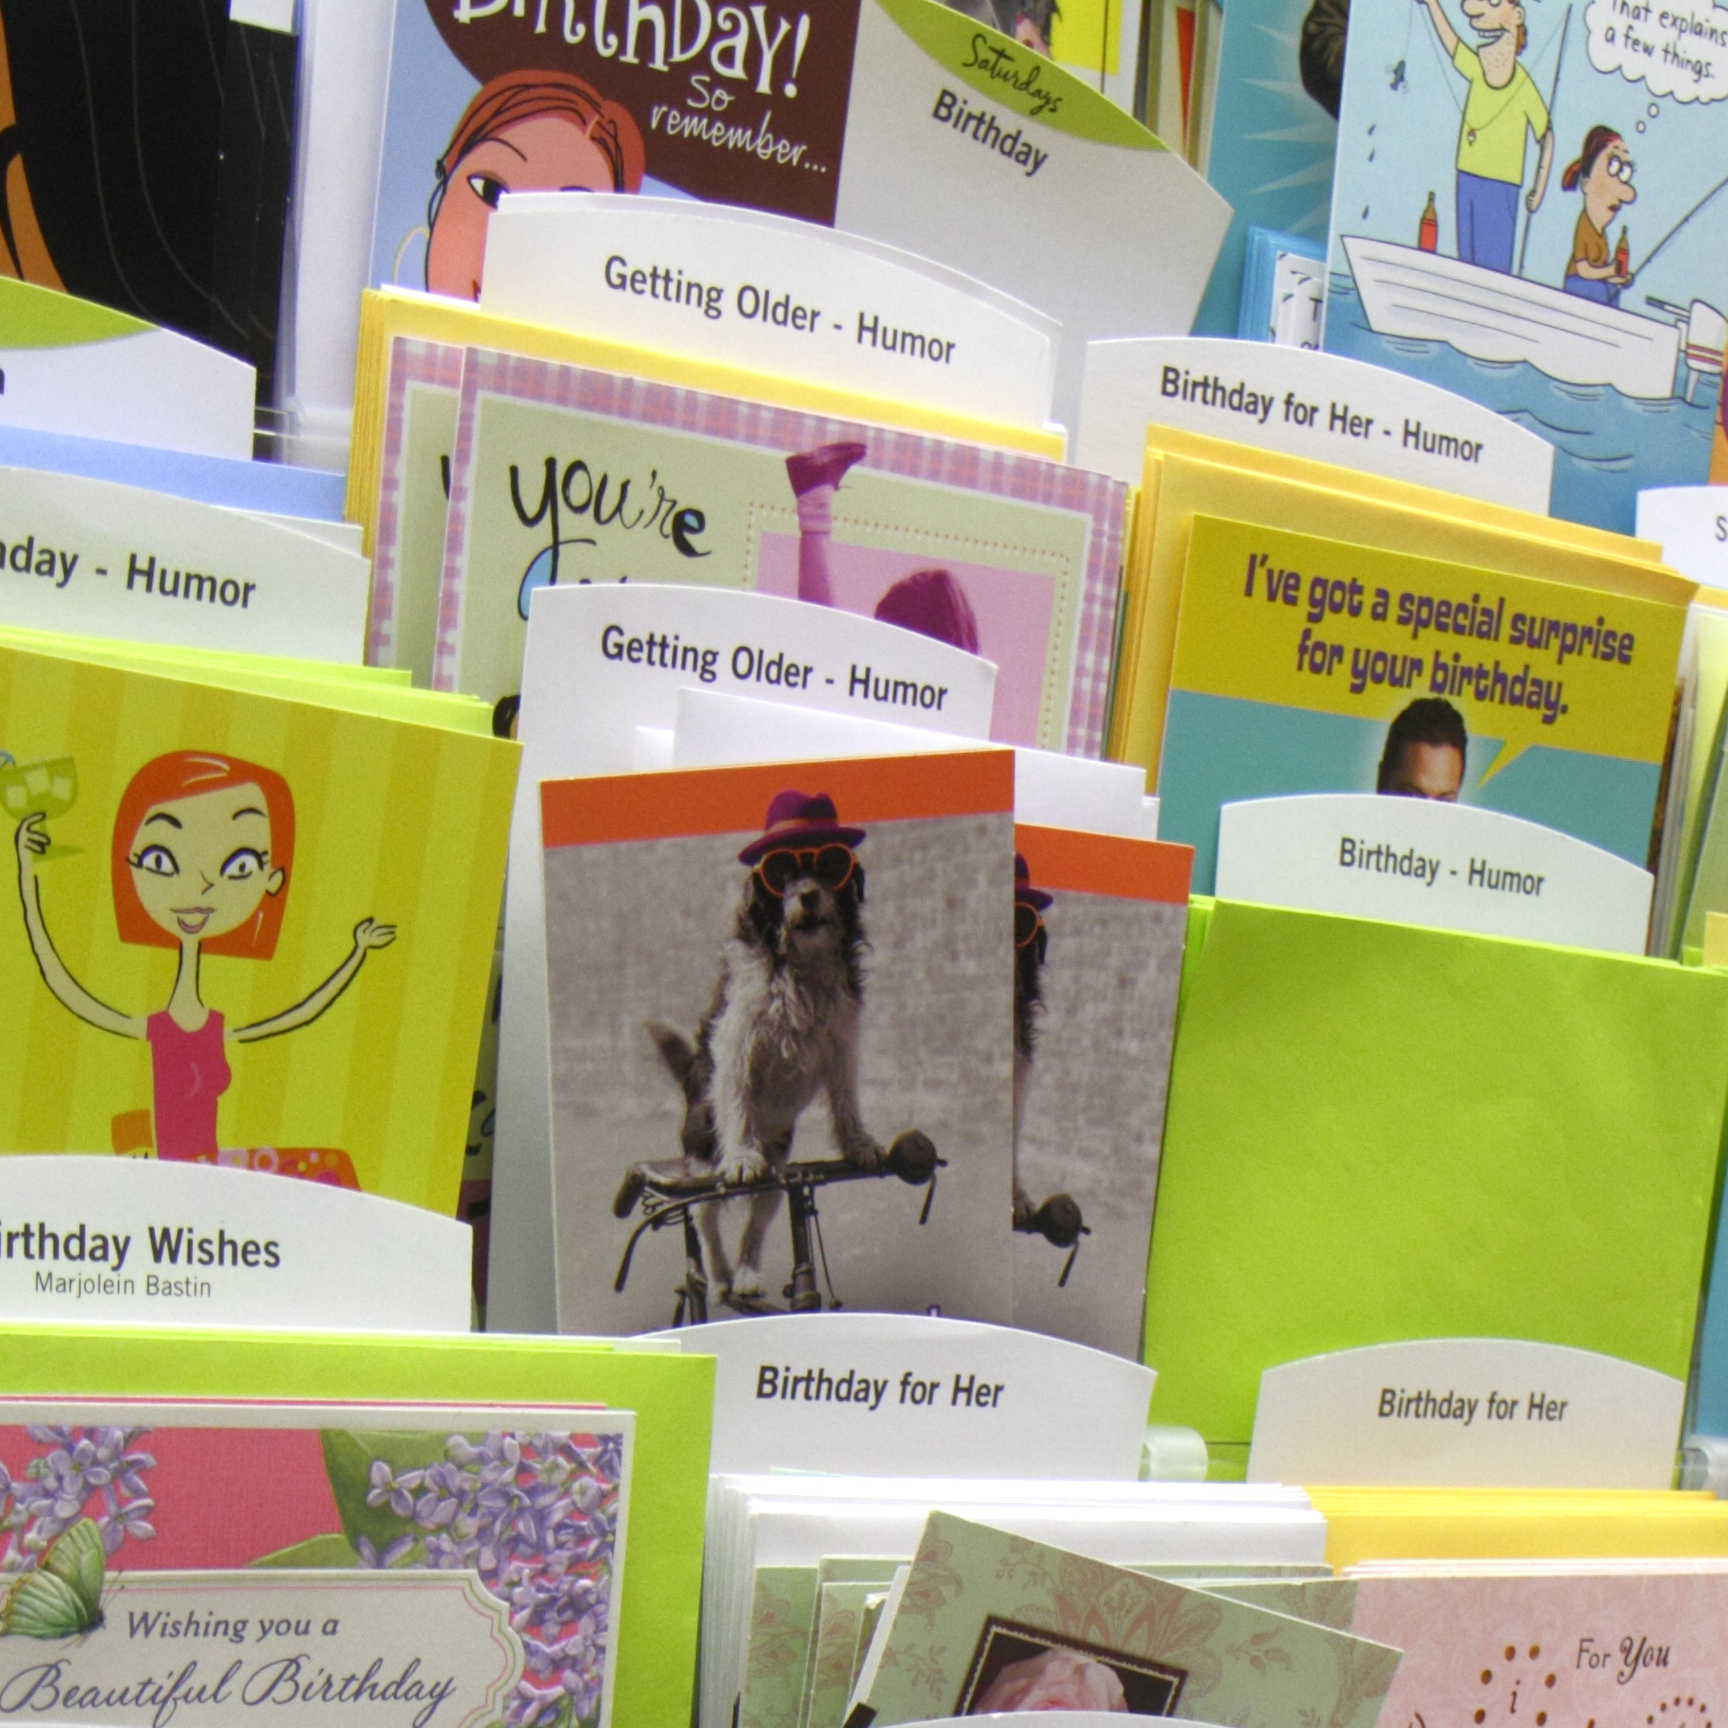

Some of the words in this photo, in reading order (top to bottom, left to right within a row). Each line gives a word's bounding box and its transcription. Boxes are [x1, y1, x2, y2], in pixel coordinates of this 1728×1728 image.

[1605, 26, 1615, 43] a
[1624, 24, 1654, 57] few
[1659, 11, 1728, 47] explains
[931, 89, 1050, 178] Birthday
[604, 254, 724, 319] Getting
[736, 285, 821, 333] Older
[857, 314, 956, 365] Humor
[1161, 365, 1274, 424] Birthday
[1284, 392, 1320, 426] for
[1328, 402, 1374, 440] Her
[1402, 419, 1483, 463] Humor
[126, 554, 256, 601] Humor
[1244, 553, 1299, 606] I've
[1307, 576, 1363, 621] got
[1371, 589, 1388, 621] a
[1397, 591, 1502, 642] special
[1509, 617, 1635, 664] surprise
[601, 625, 719, 682] Getting
[731, 645, 813, 688] Older
[849, 664, 948, 711] Humor
[1297, 628, 1343, 675] for
[1350, 644, 1423, 694] your
[1430, 651, 1568, 723] birthday.
[1339, 837, 1441, 887] Birthday
[1467, 857, 1545, 896] Humor
[148, 1225, 282, 1271] Wishes
[34, 1271, 136, 1300] Marjolein
[145, 1274, 213, 1299] Bastin
[1377, 1388, 1477, 1426] Birthday
[1487, 1391, 1519, 1419] for
[1527, 1392, 1568, 1422] Her
[126, 1609, 246, 1645] Wishing
[255, 1613, 311, 1642] you
[321, 1615, 340, 1638] a
[1575, 1638, 1611, 1670] For
[1618, 1635, 1670, 1685] You
